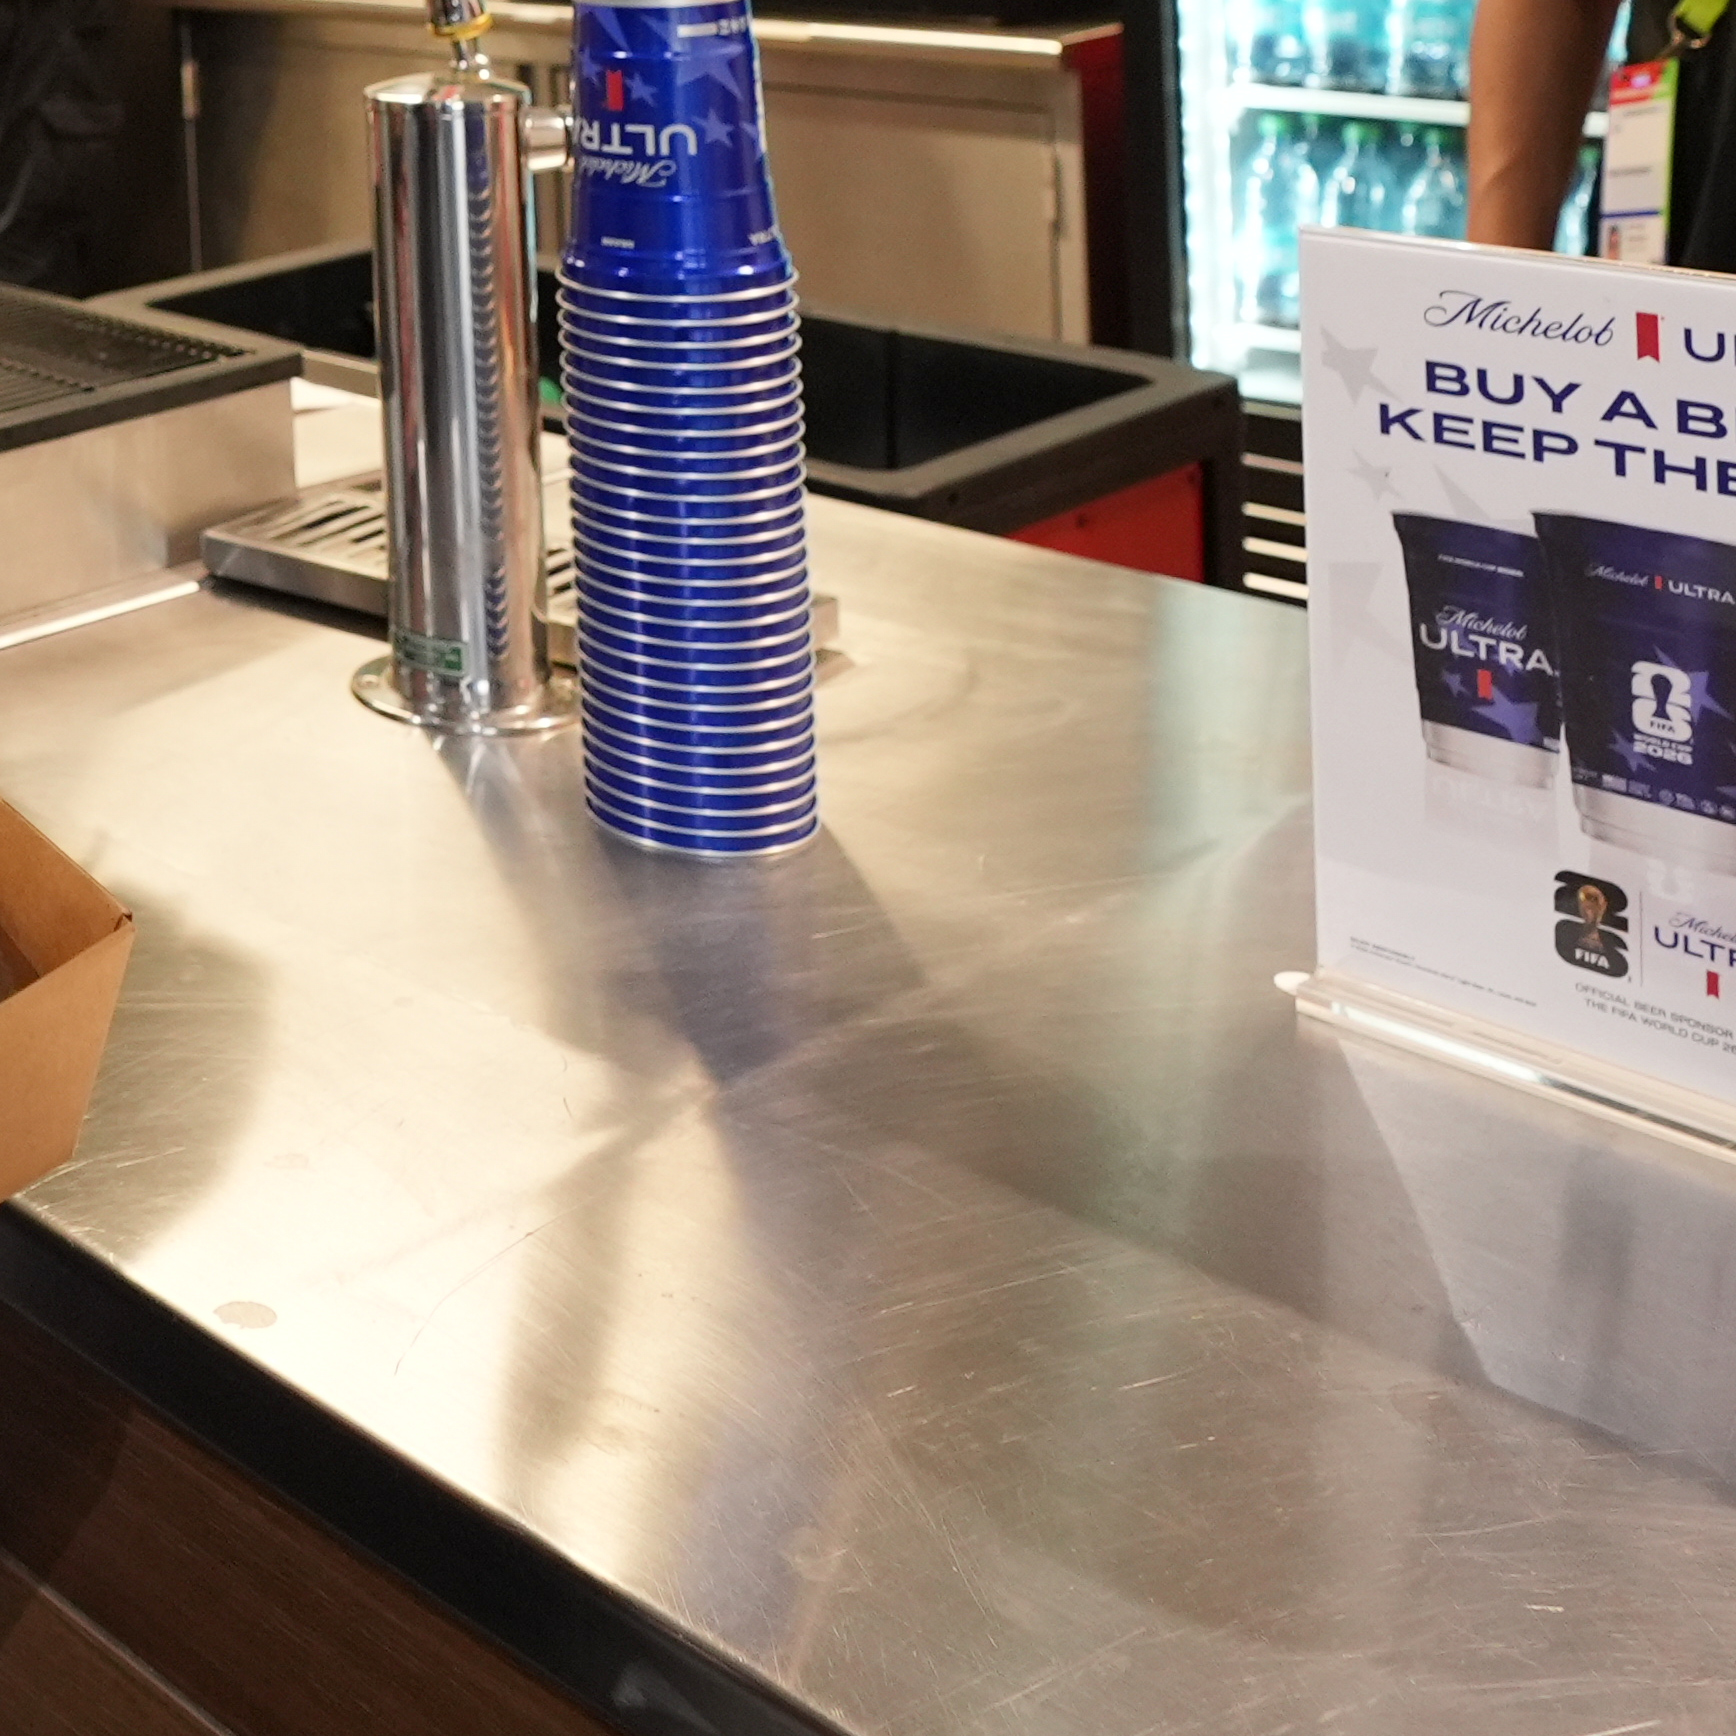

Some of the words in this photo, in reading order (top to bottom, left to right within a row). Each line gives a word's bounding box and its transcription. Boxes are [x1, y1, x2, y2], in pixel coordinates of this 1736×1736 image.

[1423, 289, 1615, 347] Michelob
[1684, 327, 1736, 366] U
[1425, 360, 1582, 414] BUY
[1600, 390, 1658, 431] A
[1676, 399, 1736, 442] B
[1378, 403, 1579, 464] KEEP
[1588, 563, 1650, 588] Michelob
[1668, 579, 1736, 606] ULTRA
[1436, 605, 1528, 641] Michelob
[1419, 623, 1554, 676] ULTRA
[1649, 719, 1677, 734] FIFA
[1632, 740, 1694, 766] 2026
[1574, 947, 1611, 970] FIFA
[1576, 982, 1629, 1007] OFFICIAL
[1634, 1000, 1667, 1019] BEER
[1670, 1011, 1735, 1040] SPONSOR
[1584, 997, 1609, 1015] THE
[1611, 1006, 1638, 1023] FIFA
[1642, 1016, 1689, 1039] WORLD
[1691, 1031, 1720, 1047] CUP
